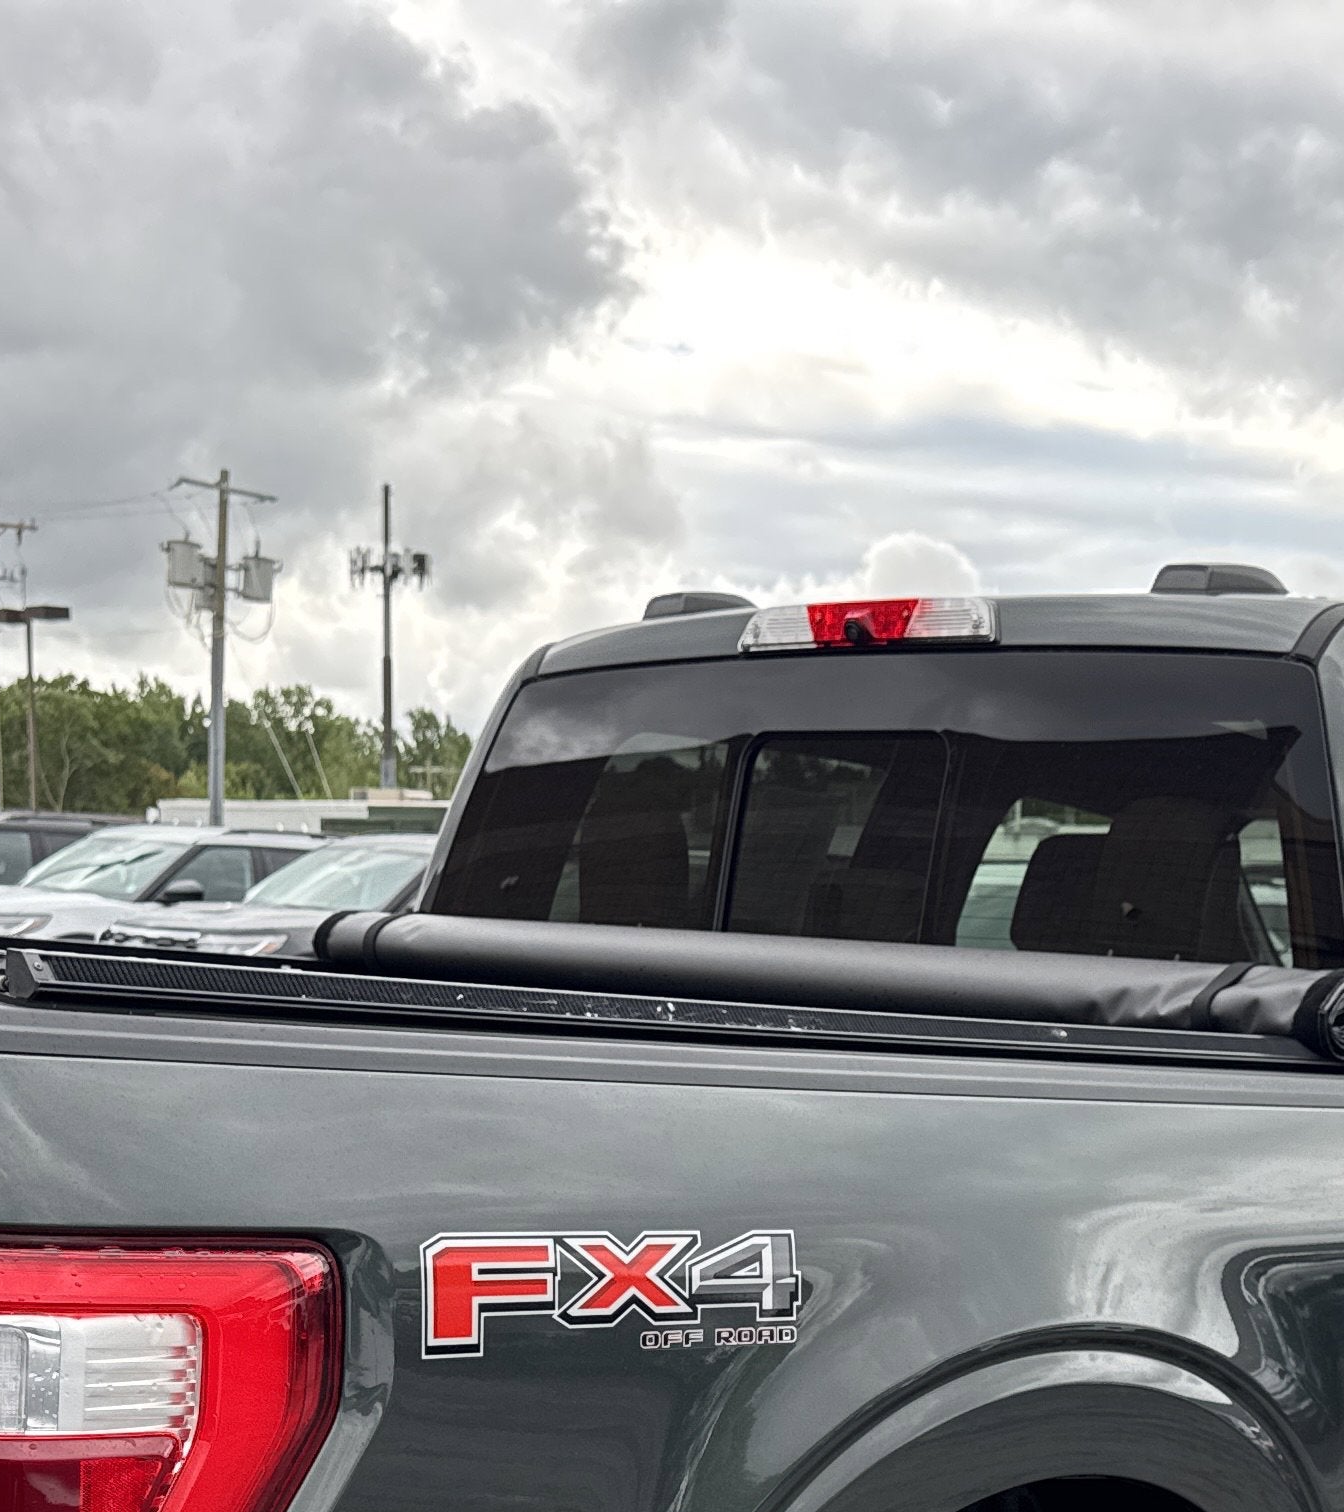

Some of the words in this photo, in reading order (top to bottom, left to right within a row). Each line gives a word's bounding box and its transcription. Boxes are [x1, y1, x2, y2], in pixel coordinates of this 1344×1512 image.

[420, 1229, 802, 1360] FX4
[639, 1328, 704, 1350] OFF
[714, 1324, 798, 1347] ROAD
